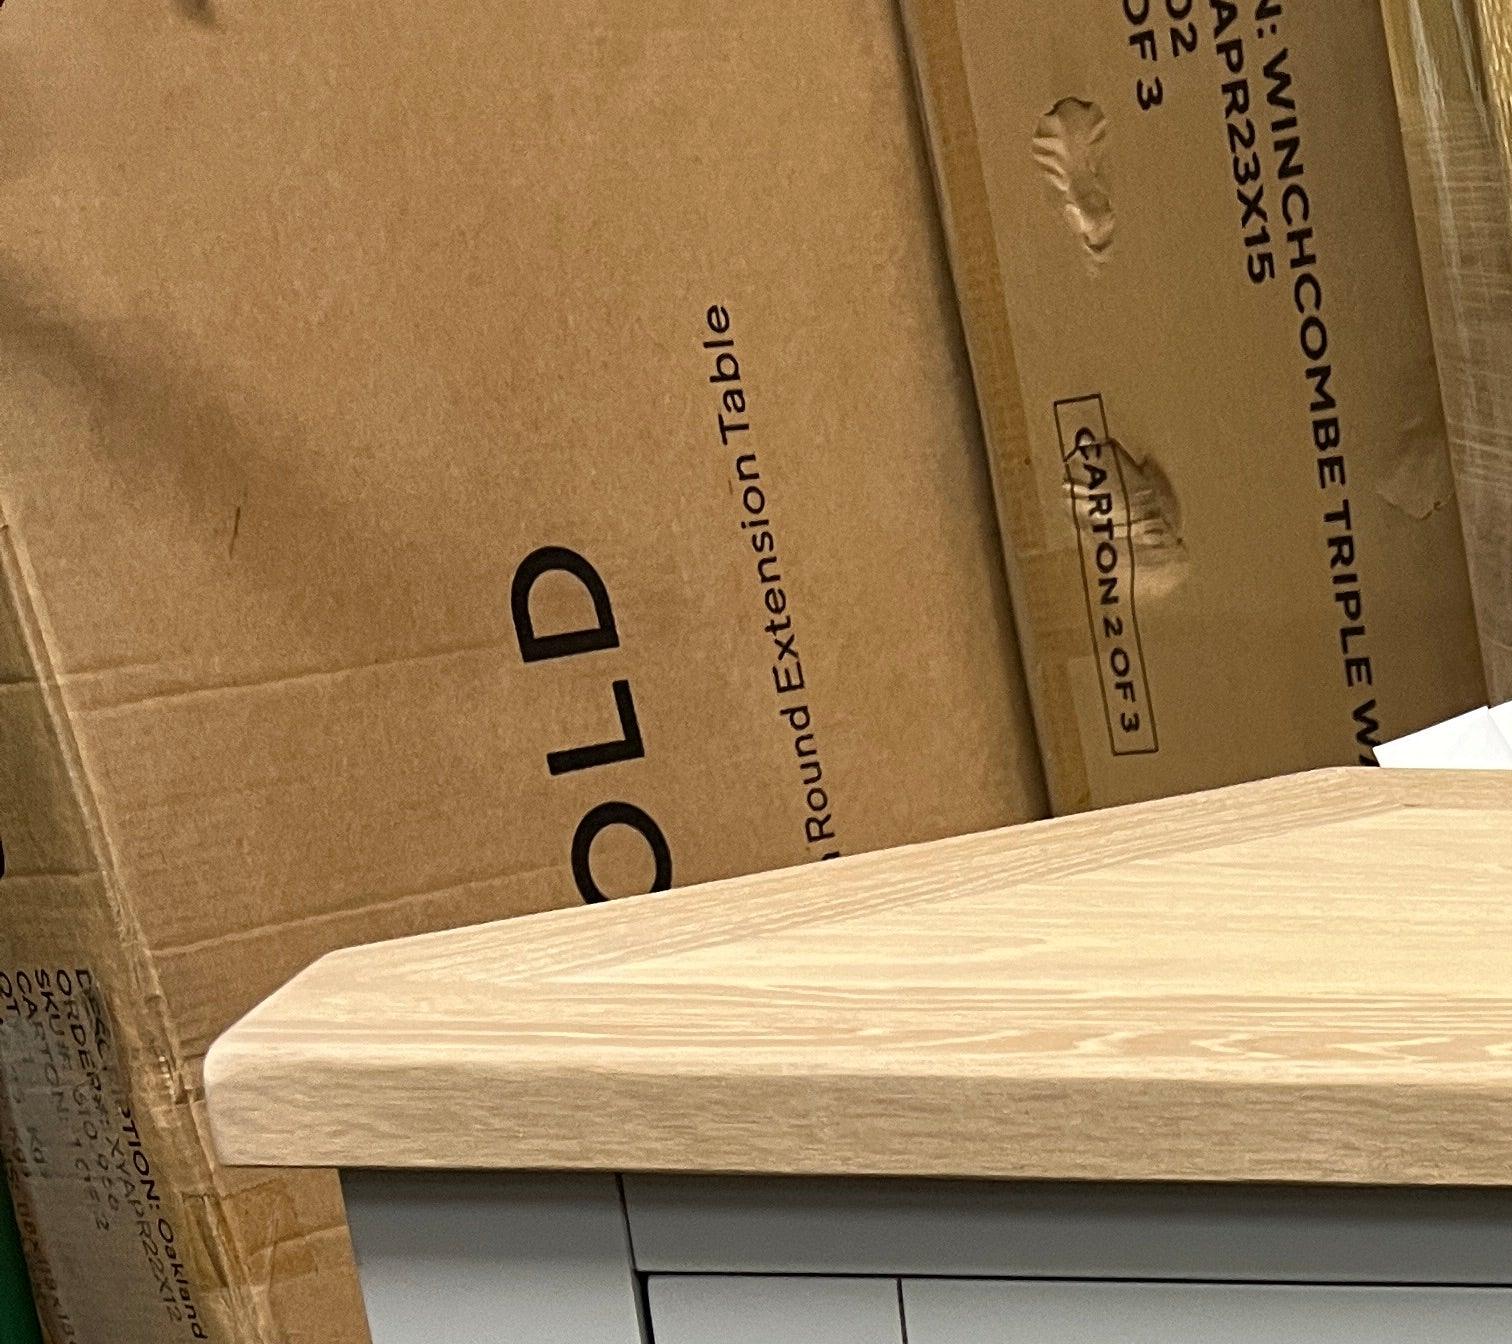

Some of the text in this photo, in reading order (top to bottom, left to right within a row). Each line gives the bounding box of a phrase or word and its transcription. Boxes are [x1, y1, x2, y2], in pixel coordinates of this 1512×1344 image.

[1136, 75, 1164, 111] 3
[1262, 46, 1347, 490] WINCHCOMBE
[1322, 498, 1374, 688] TRIPLE
[702, 304, 836, 843] Round Extension Table
[1073, 425, 1142, 734] CARTON 2 OF 3
[157, 1217, 209, 1340] Oakland
